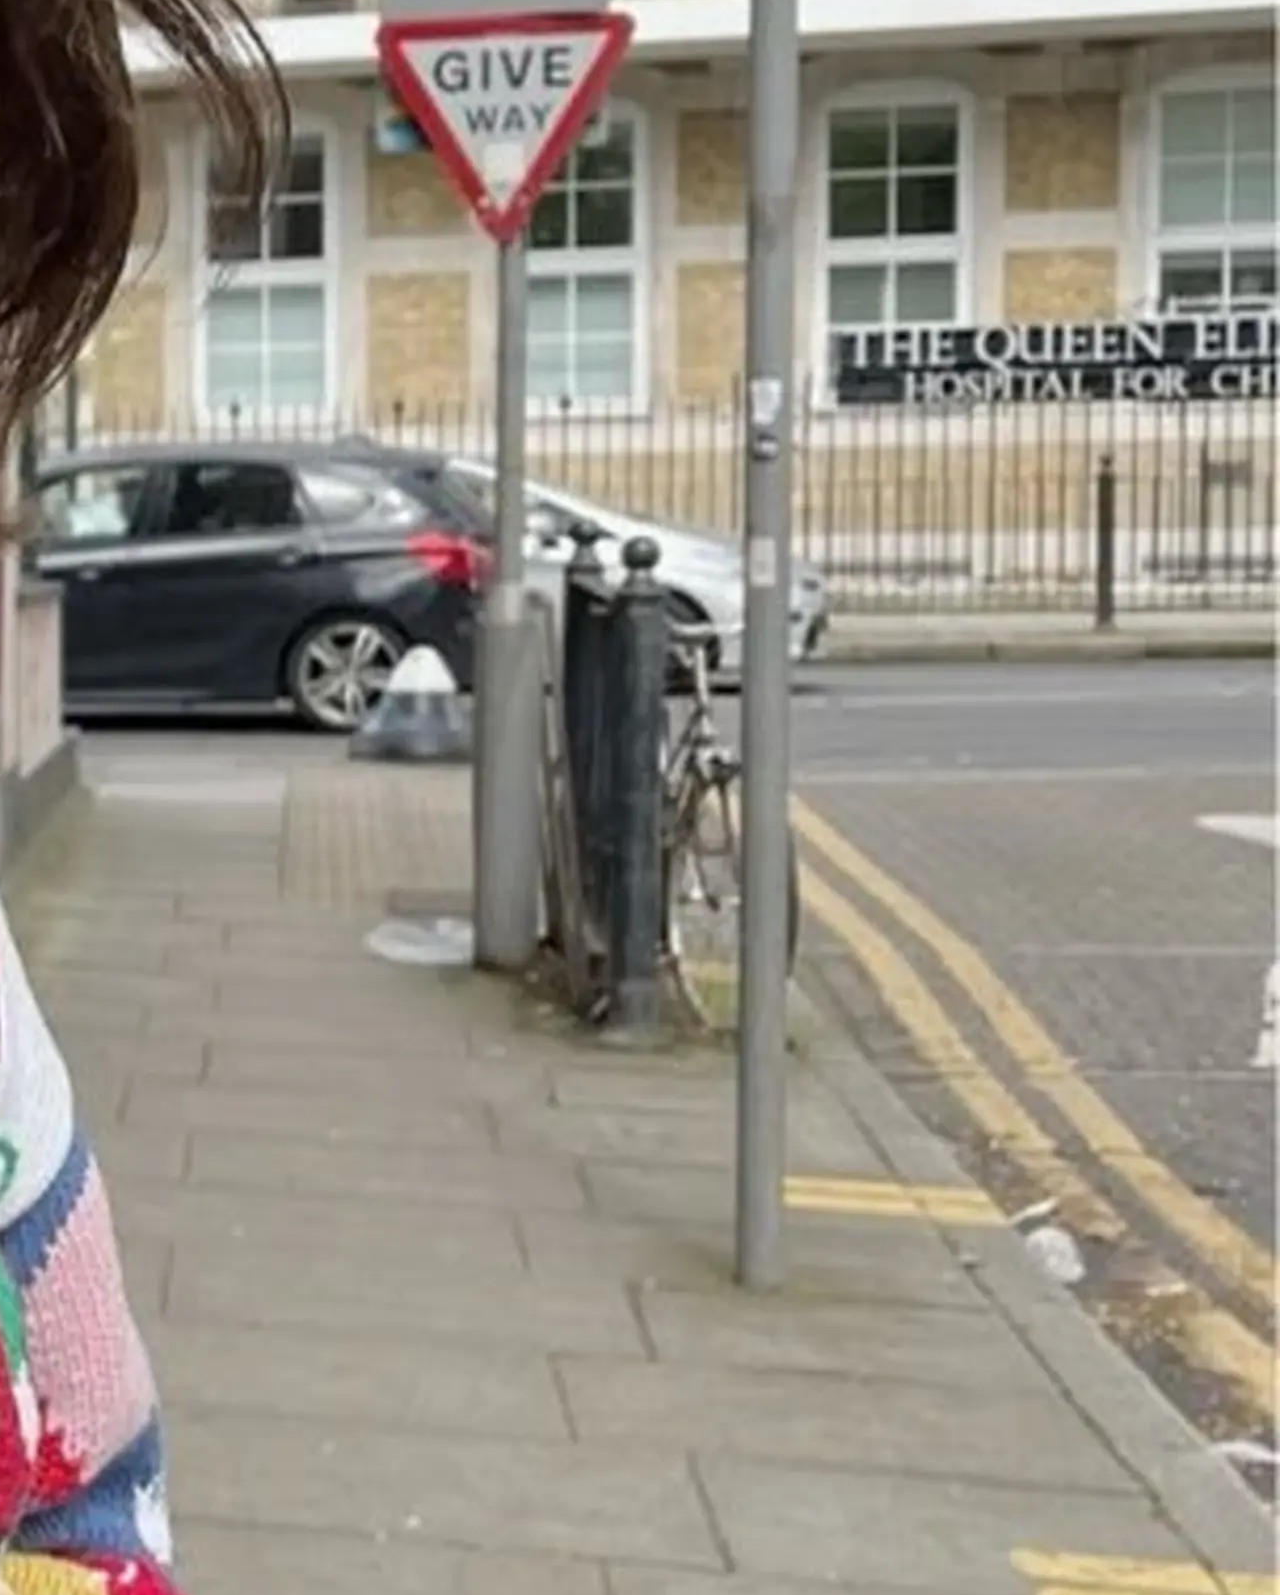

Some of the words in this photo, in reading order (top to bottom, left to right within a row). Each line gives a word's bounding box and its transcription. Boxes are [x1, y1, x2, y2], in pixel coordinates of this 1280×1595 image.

[433, 45, 574, 95] GIVE
[465, 102, 551, 136] WAY
[849, 325, 958, 370] THE
[973, 318, 1166, 373] QUEEN
[901, 368, 1093, 406] HOSPITAL
[1113, 364, 1190, 400] FOR
